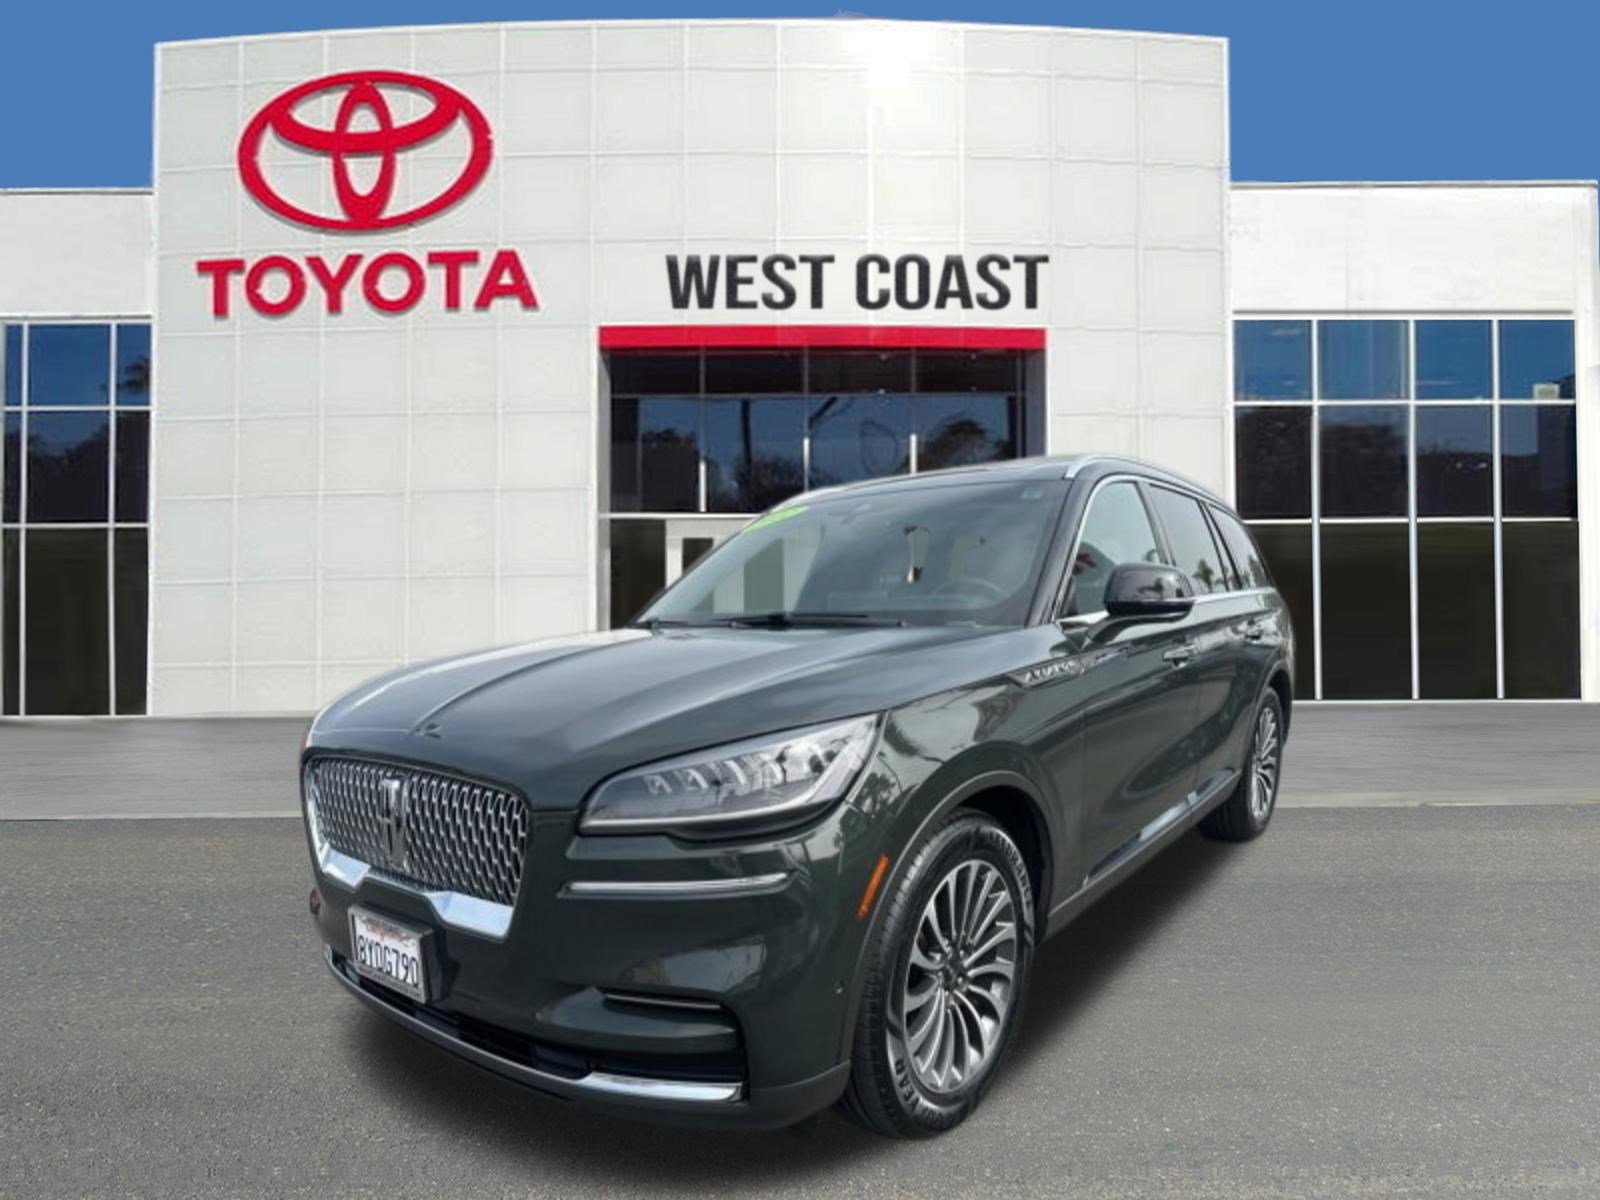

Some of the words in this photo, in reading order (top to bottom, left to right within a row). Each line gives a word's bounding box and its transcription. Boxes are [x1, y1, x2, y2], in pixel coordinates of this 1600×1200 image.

[197, 249, 540, 318] TOYOTA
[666, 254, 835, 310] WEST
[855, 254, 1049, 310] COAST
